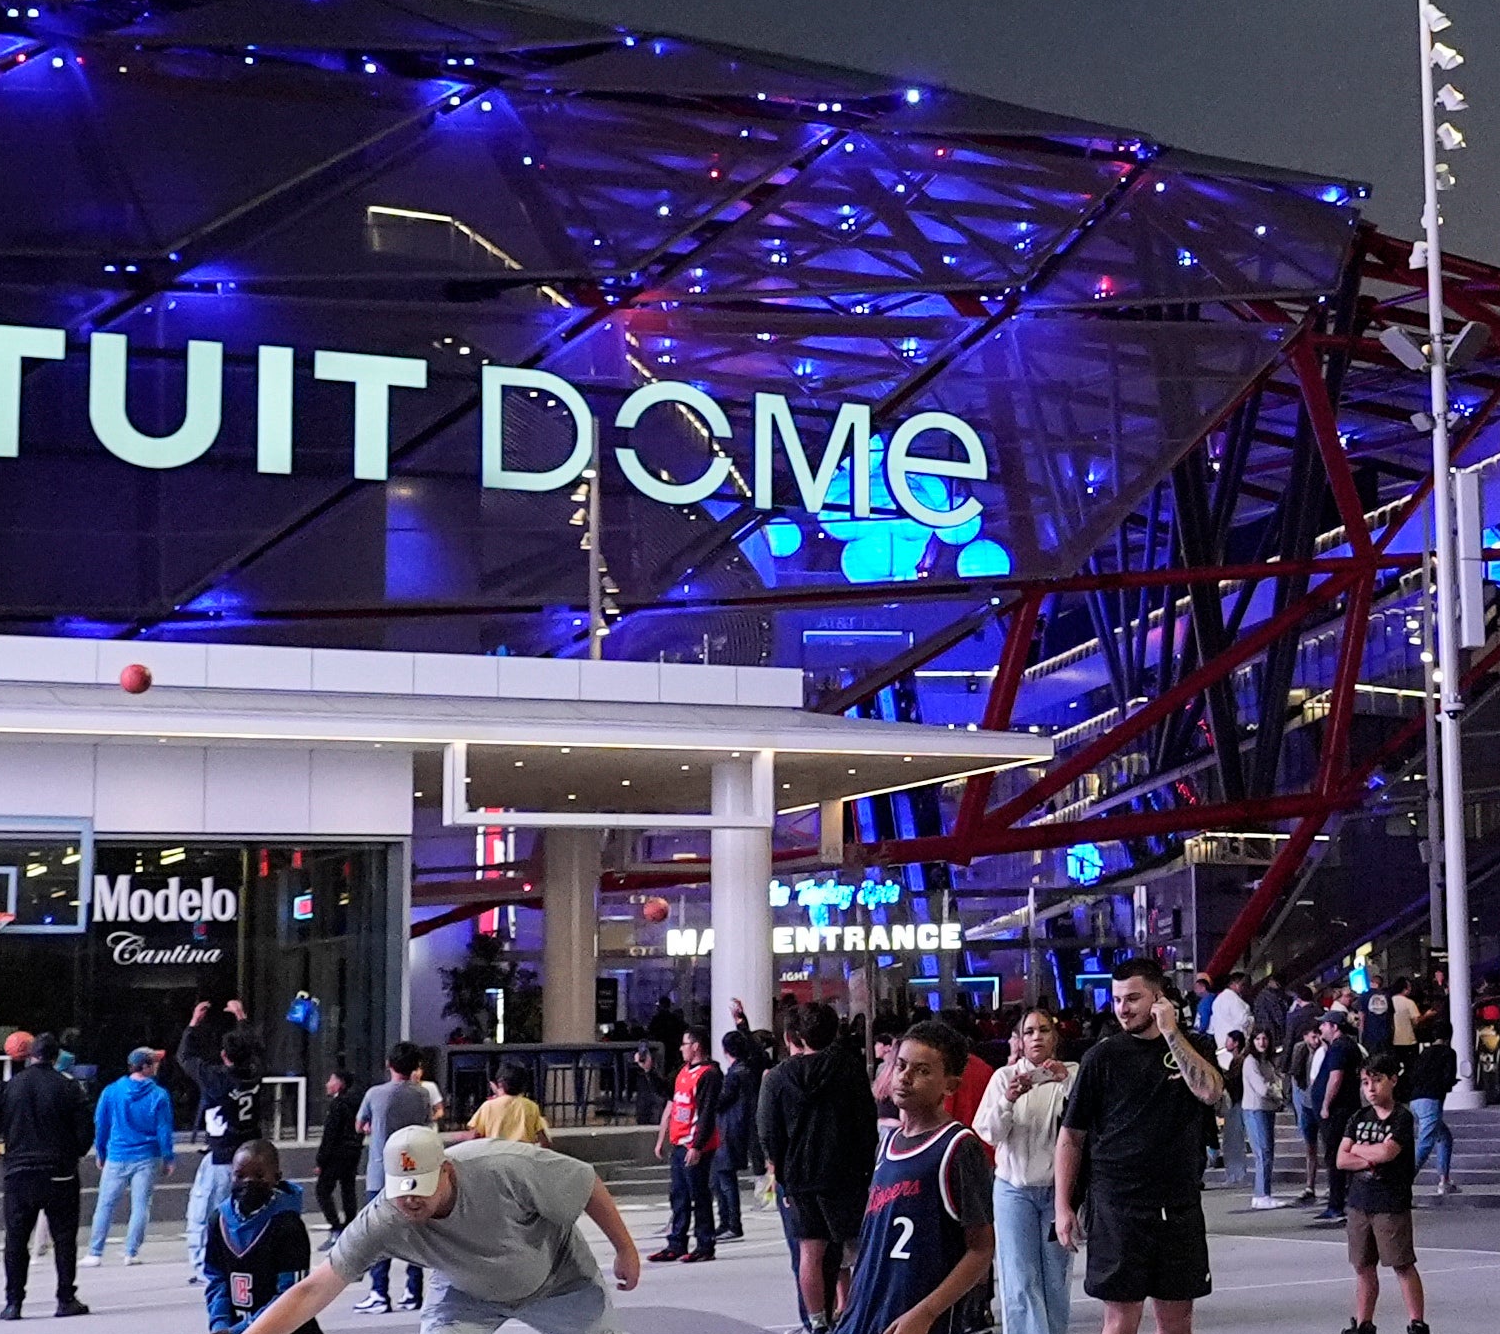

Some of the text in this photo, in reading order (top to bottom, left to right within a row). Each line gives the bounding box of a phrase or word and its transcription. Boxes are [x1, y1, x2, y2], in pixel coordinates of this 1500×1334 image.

[92, 874, 237, 923] Modelo
[106, 931, 223, 965] Cantina
[772, 924, 963, 954] ENTRANCE
[890, 1216, 915, 1260] 2
